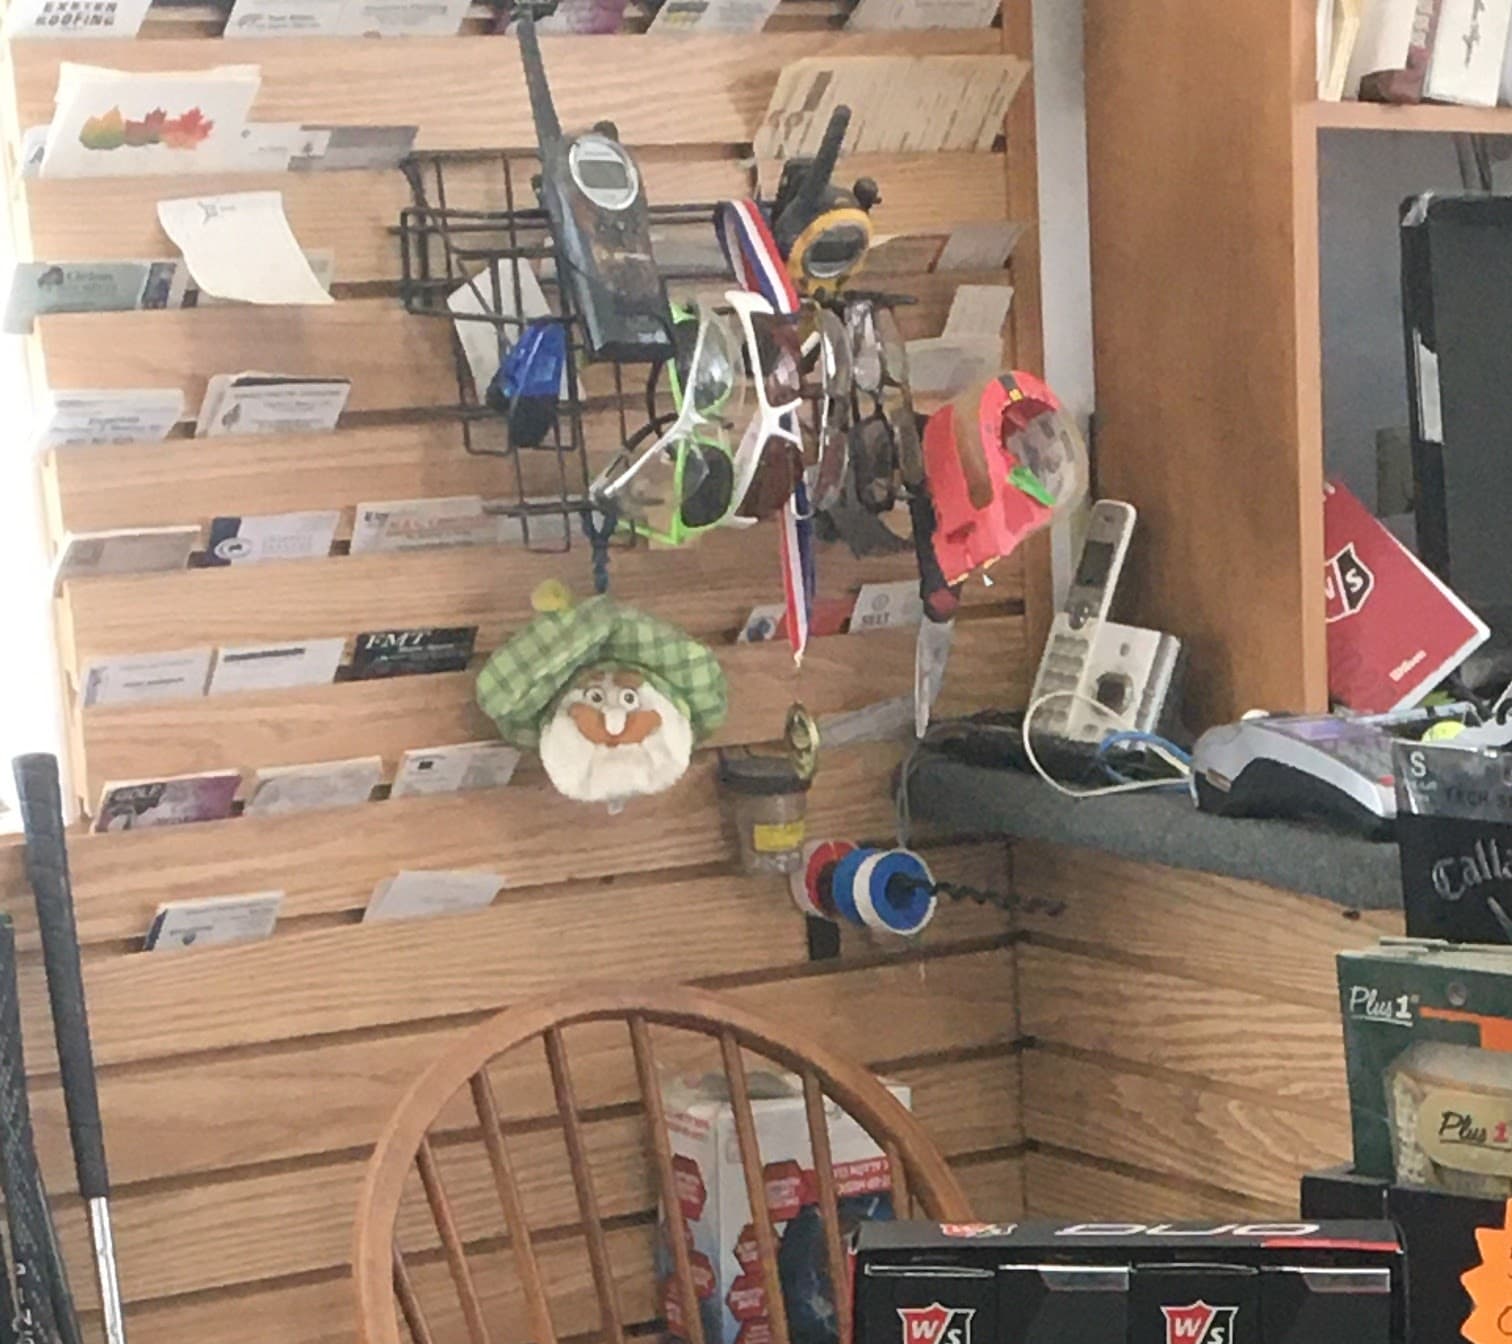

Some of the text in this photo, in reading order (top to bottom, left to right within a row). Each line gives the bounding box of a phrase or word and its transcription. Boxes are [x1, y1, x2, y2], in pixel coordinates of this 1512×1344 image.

[1409, 751, 1427, 778] S
[1350, 986, 1391, 1018] Plus
[1438, 1111, 1487, 1144] Plus
